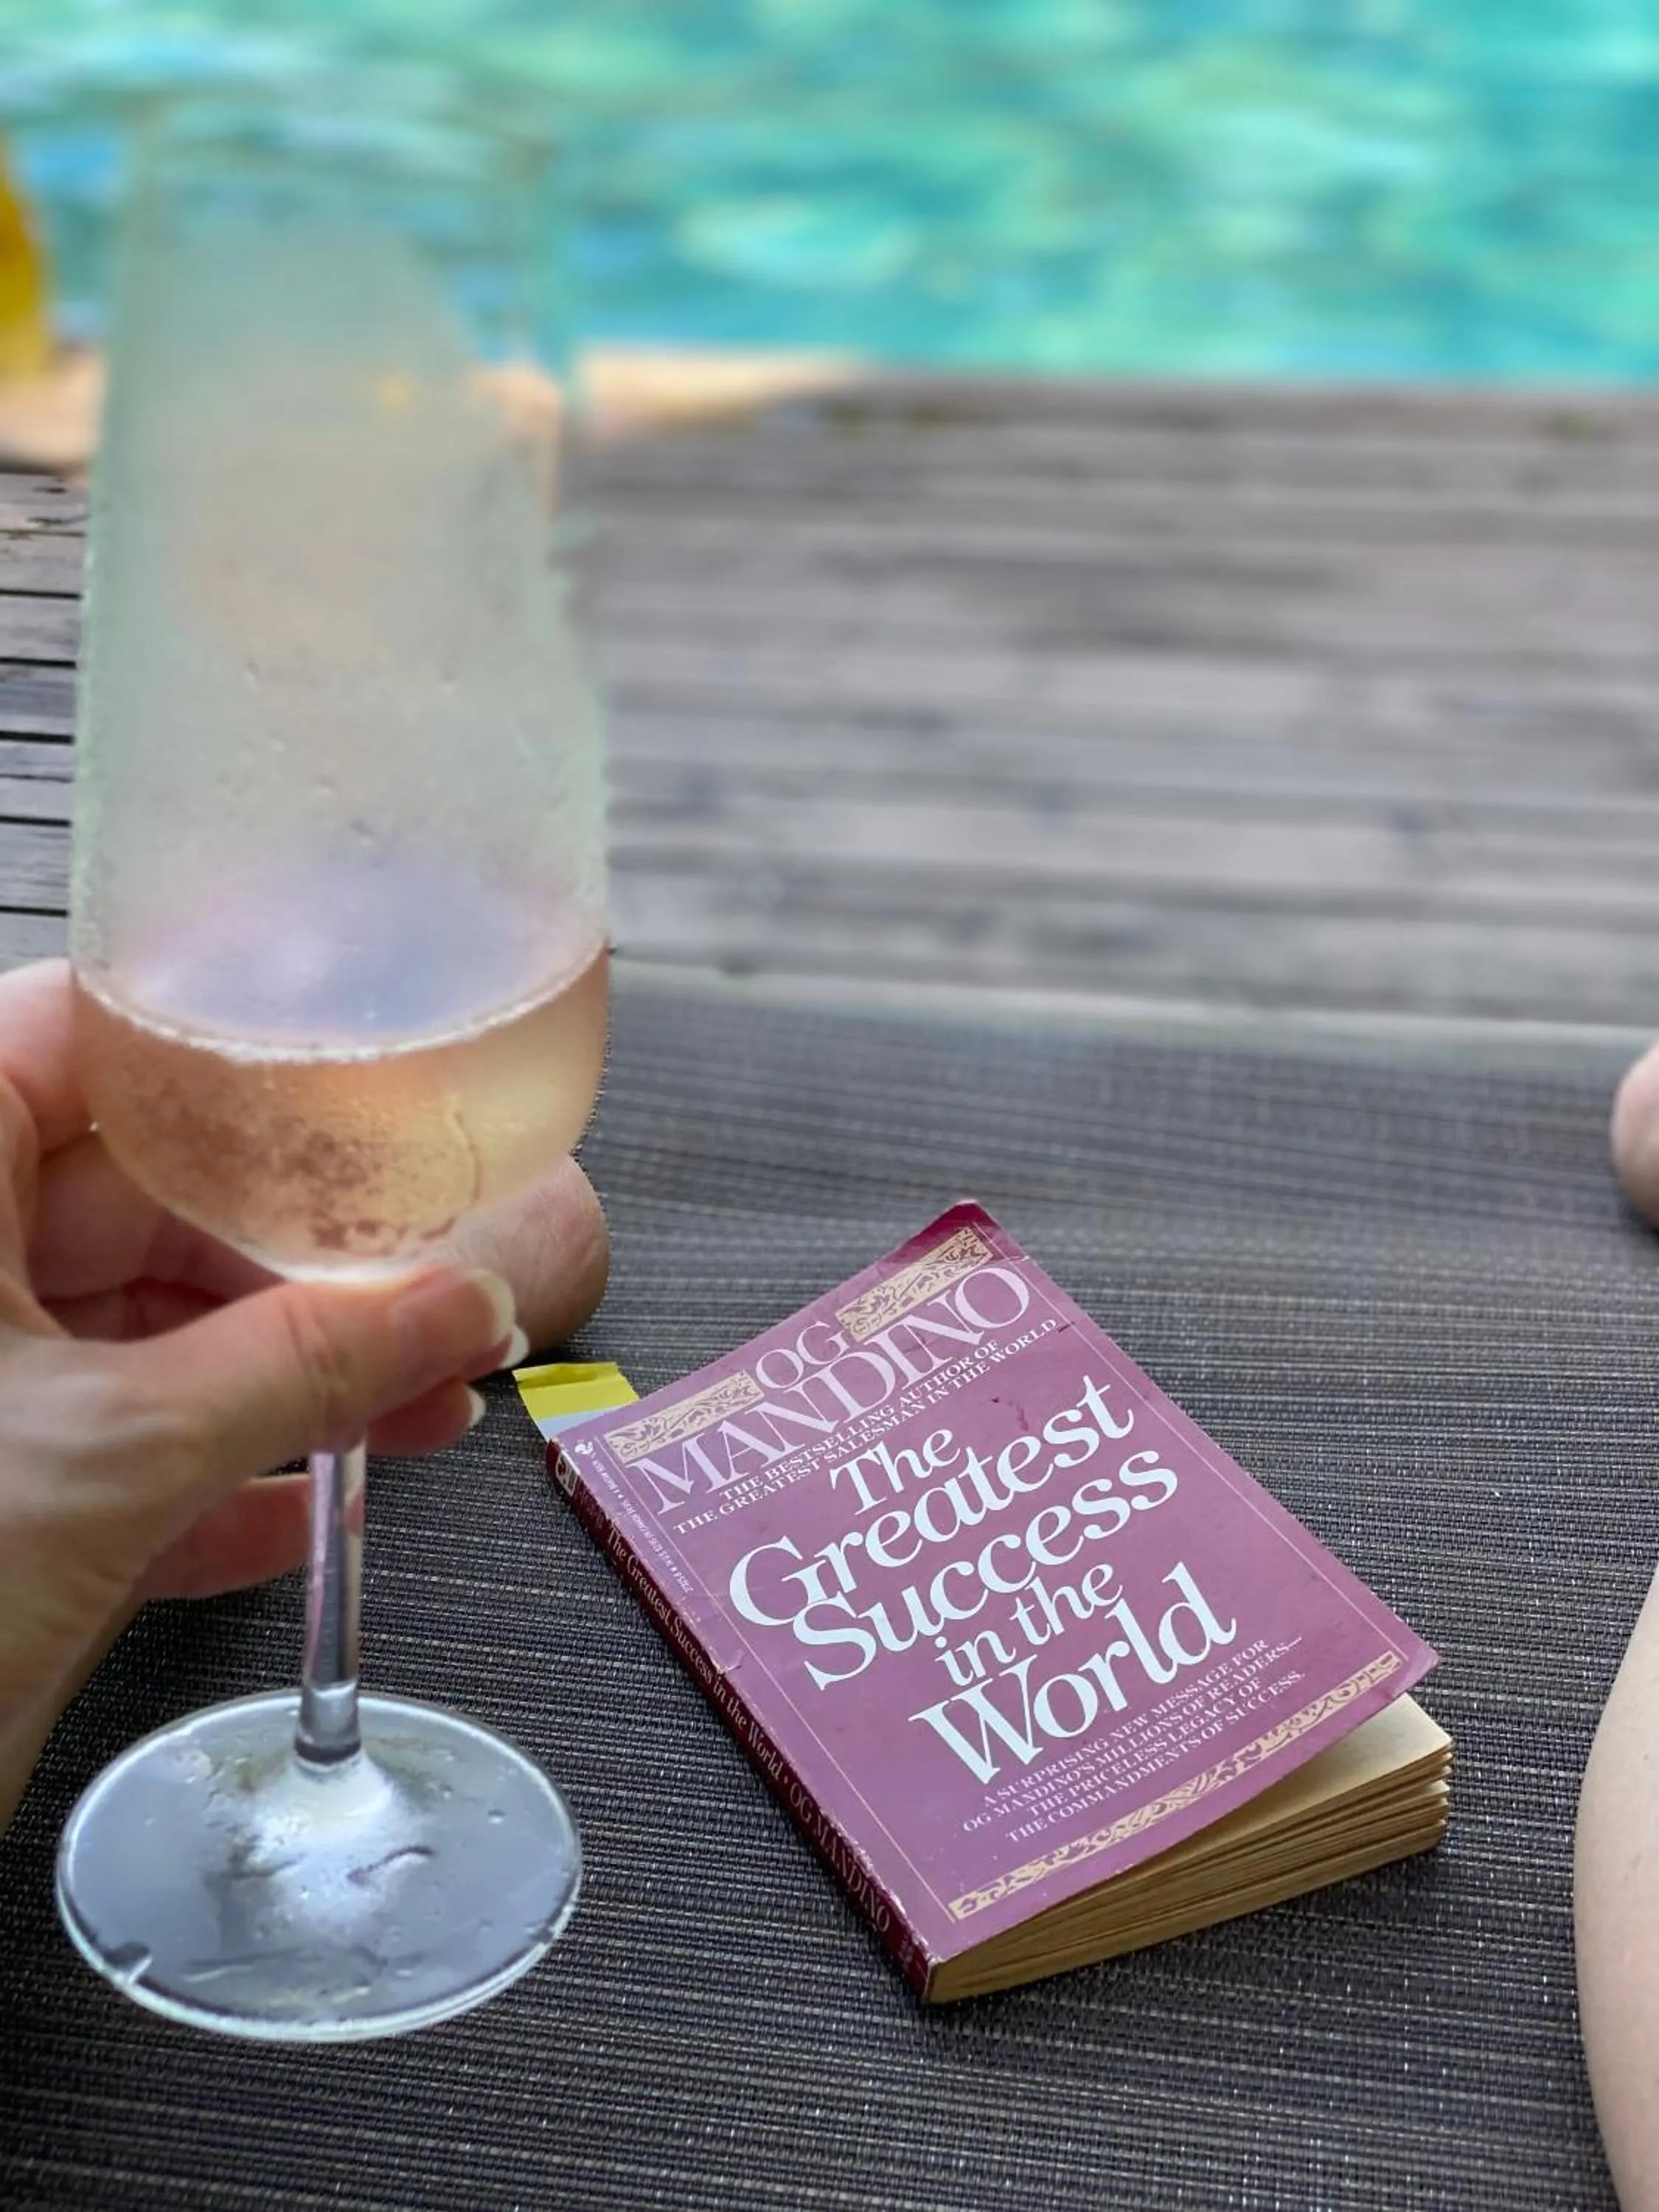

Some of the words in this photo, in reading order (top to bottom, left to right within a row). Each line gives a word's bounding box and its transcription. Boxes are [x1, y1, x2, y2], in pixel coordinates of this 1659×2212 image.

[625, 1267, 1029, 1514] MANDINO
[673, 1510, 718, 1534] THE
[719, 1460, 821, 1515] GREATEST
[824, 1402, 925, 1463] SALESMAN
[927, 1387, 949, 1405] IN
[948, 1364, 990, 1389] THE
[990, 1319, 1059, 1363] WORLD
[720, 1476, 763, 1500] THE
[765, 1405, 894, 1479] BESTSELLING
[899, 1357, 975, 1407] AUTHOR
[975, 1340, 1000, 1359] OF
[756, 1319, 852, 1390] OG
[729, 1374, 1134, 1625] Greatest
[830, 1429, 960, 1515] The
[793, 1450, 1178, 1691] Success
[934, 1630, 1016, 1686] in
[1009, 1563, 1123, 1646] the
[607, 1526, 627, 1561] The
[627, 1555, 670, 1627] Greatest
[669, 1616, 713, 1685] Success
[713, 1676, 726, 1703] in
[726, 1697, 747, 1729] the
[748, 1720, 784, 1781] World
[790, 1783, 812, 1822] OG
[908, 1561, 1237, 1784] World
[984, 1795, 997, 1806] A
[996, 1738, 1109, 1798] SURPRISING
[1110, 1714, 1148, 1741] NEW
[1150, 1663, 1233, 1719] MESSAGE
[1232, 1639, 1269, 1666] FOR
[1027, 1792, 1068, 1818] THE
[1068, 1738, 1167, 1798] PRICELESS
[1168, 1697, 1236, 1743] LEGACY
[1238, 1677, 1263, 1697] OF
[963, 1815, 992, 1832] OG
[993, 1761, 1095, 1818] MANDINO'S
[1096, 1712, 1183, 1768] MILLIONS
[1183, 1695, 1205, 1716] OF
[1005, 1818, 1048, 1843] THE
[1048, 1737, 1201, 1823] COMMANDMENTS
[1200, 1719, 1225, 1740] OF
